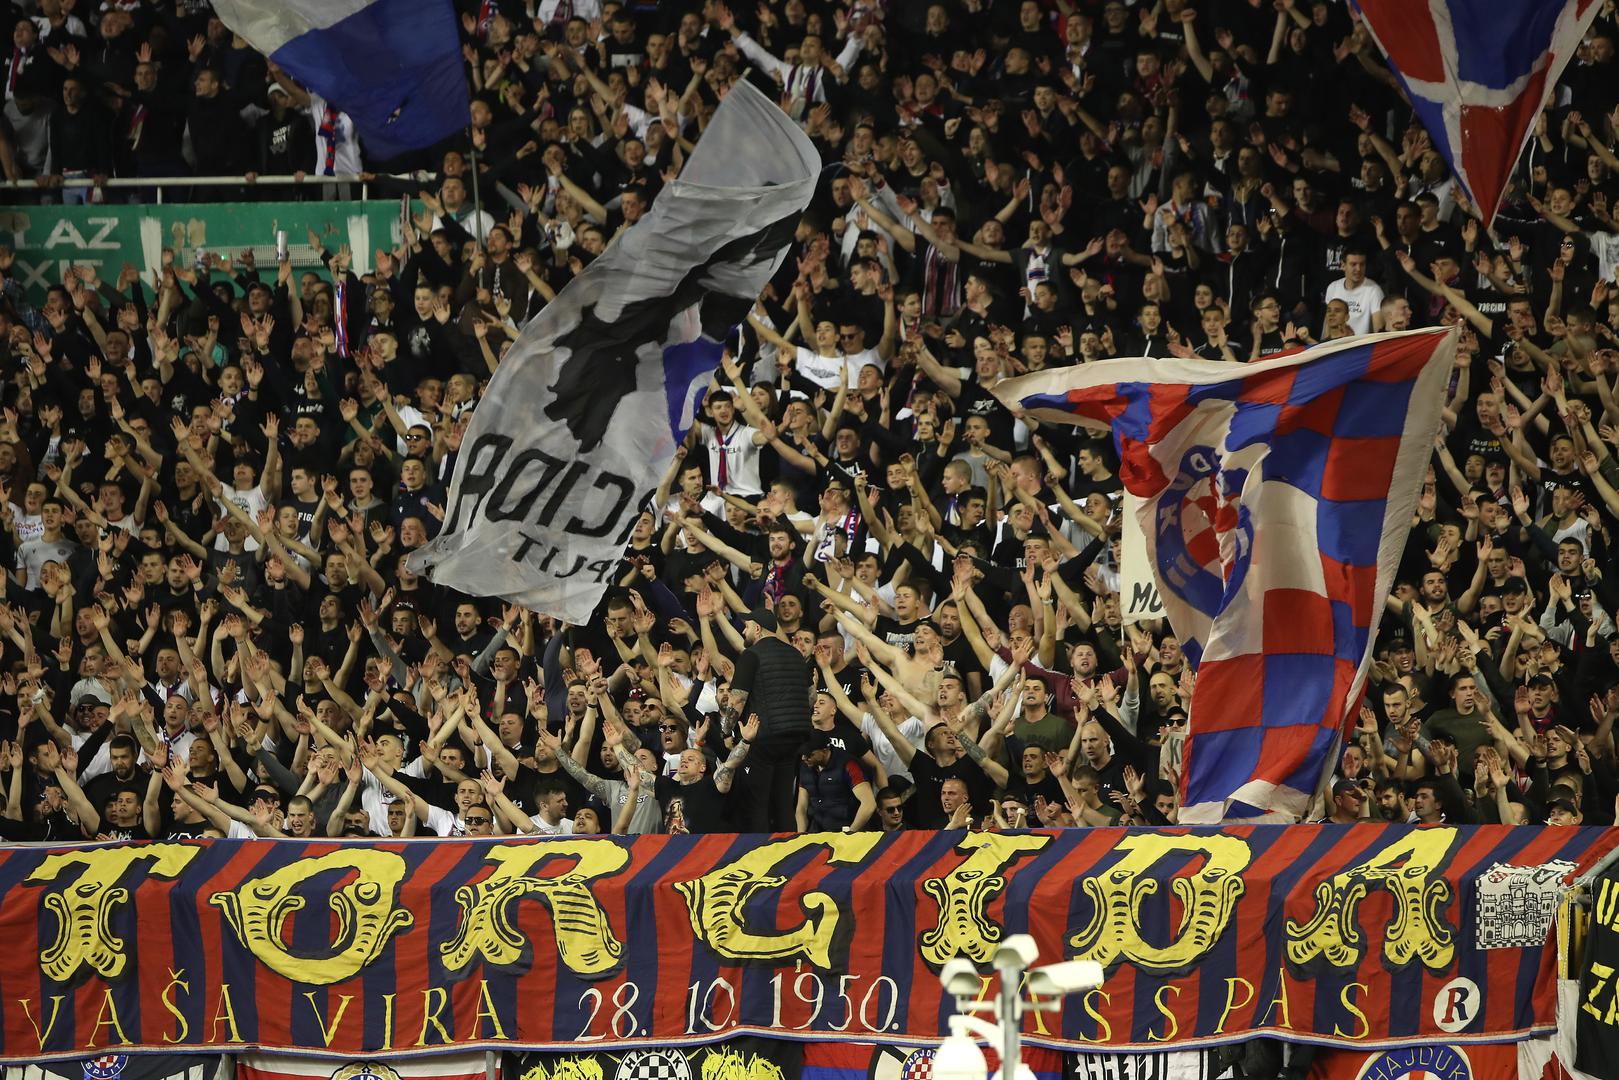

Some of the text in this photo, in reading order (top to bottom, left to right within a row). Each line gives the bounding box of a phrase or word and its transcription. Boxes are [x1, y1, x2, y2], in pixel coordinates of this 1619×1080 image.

[24, 827, 1459, 984] TORCIDA
[18, 966, 246, 1051] VAŠA
[302, 979, 510, 1051] VIRA
[573, 981, 648, 1042] 28.
[685, 976, 738, 1035] 10.
[769, 972, 899, 1033] 1950.
[1147, 967, 1370, 1042] SPAS
[85, 1062, 121, 1076] SPLIT
